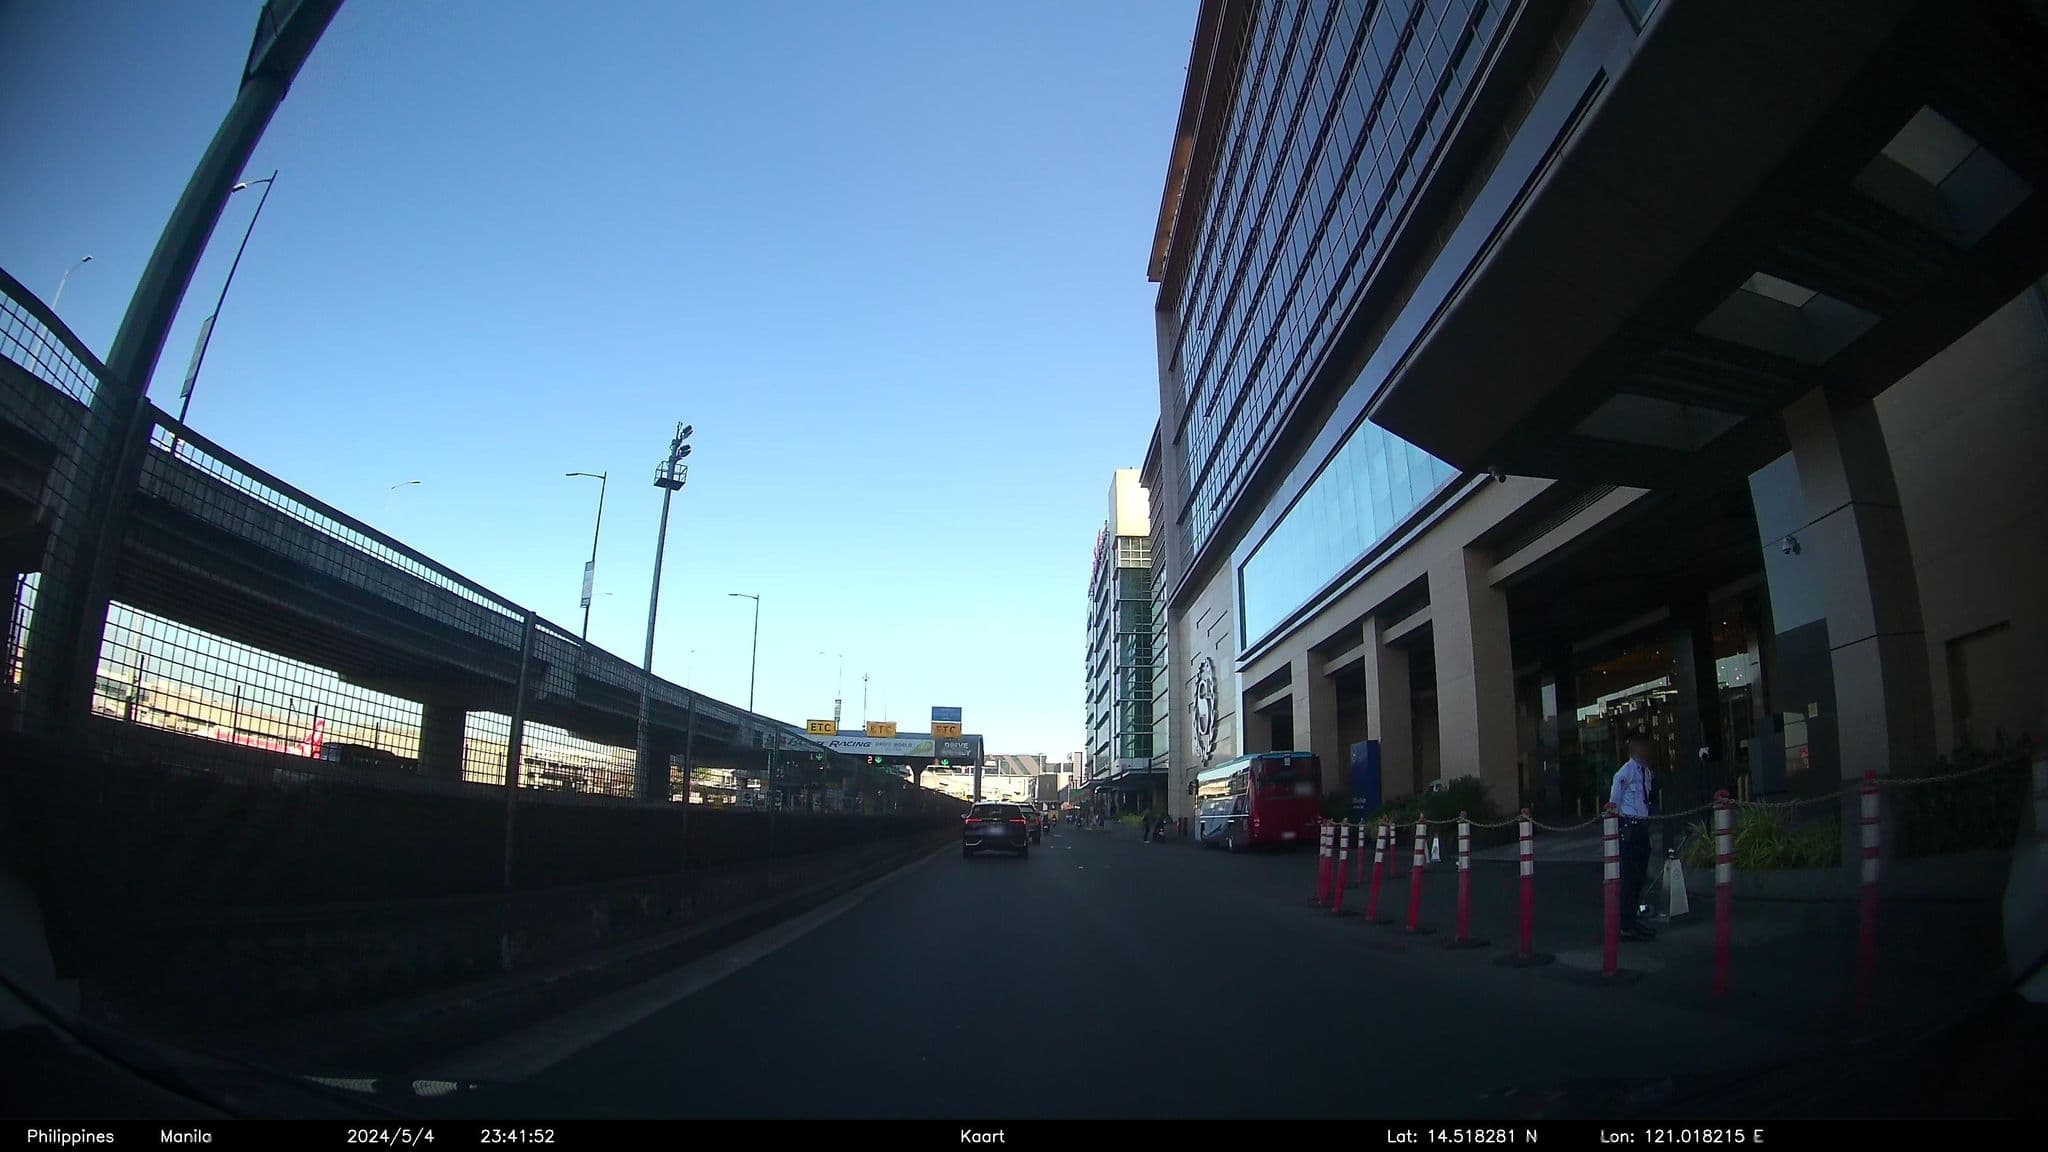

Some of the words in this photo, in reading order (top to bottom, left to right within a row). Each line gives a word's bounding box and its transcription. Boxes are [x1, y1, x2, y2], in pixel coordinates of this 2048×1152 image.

[810, 723, 832, 733] ETC
[869, 725, 893, 734] ETC
[935, 726, 957, 735] ETC
[829, 740, 872, 748] RACING
[866, 755, 873, 764] 2
